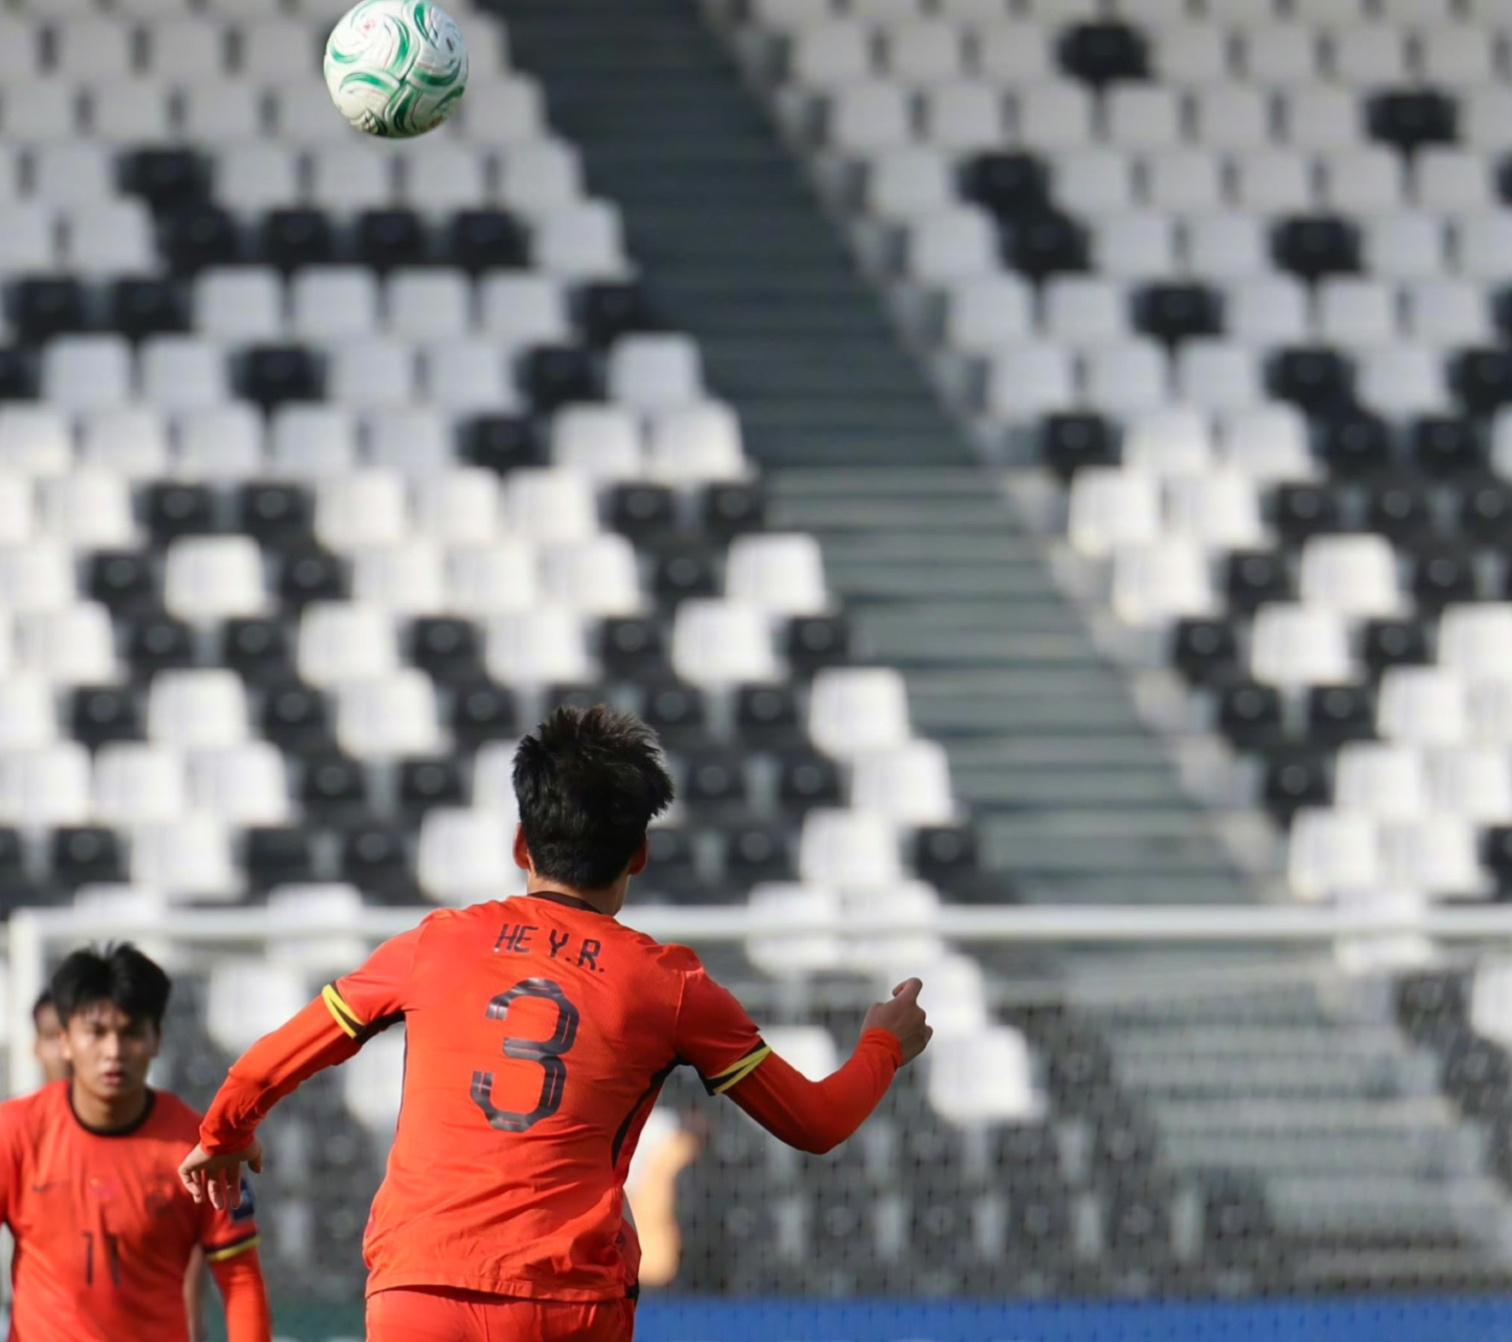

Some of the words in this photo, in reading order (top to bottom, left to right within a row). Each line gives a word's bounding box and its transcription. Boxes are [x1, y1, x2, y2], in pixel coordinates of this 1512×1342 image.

[493, 923, 539, 953] HE
[549, 929, 605, 973] Y.R.
[469, 977, 580, 1133] 3
[83, 1231, 121, 1287] 11
